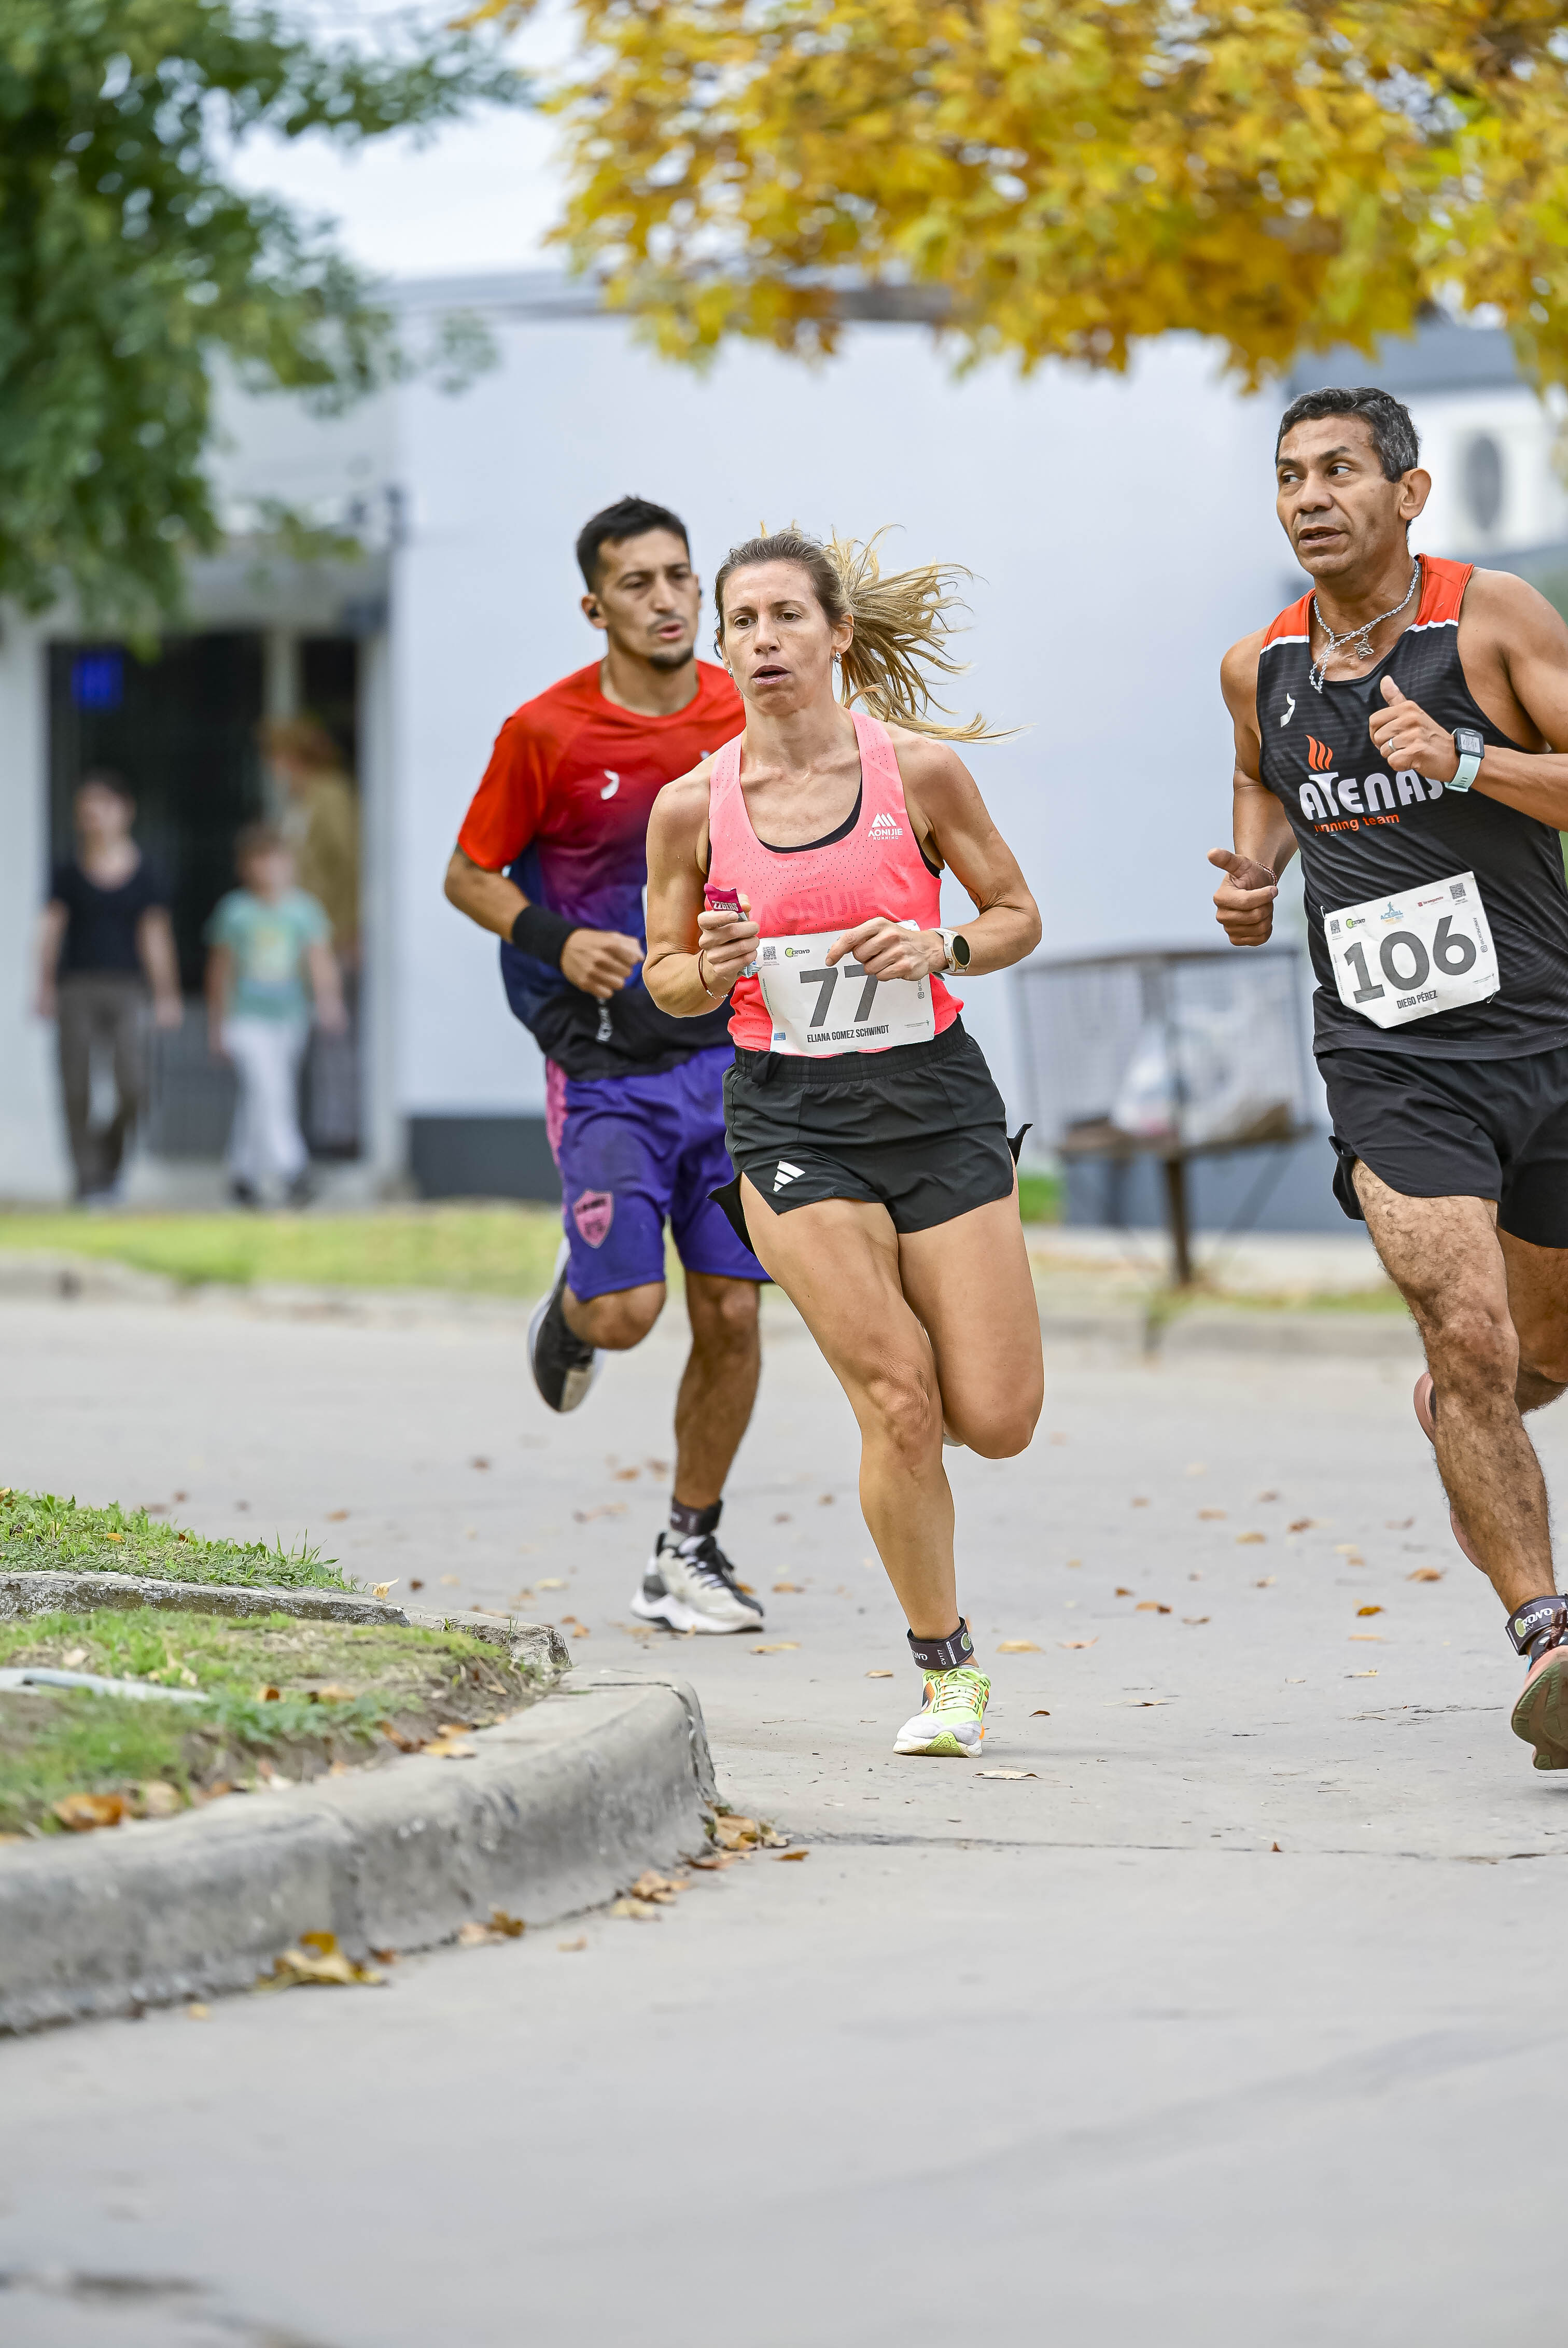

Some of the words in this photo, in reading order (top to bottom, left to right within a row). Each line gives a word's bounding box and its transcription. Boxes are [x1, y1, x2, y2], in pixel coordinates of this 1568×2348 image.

[1299, 769, 1443, 820] ATENAS
[1362, 814, 1400, 827] team
[711, 900, 739, 912] 226ERS
[1343, 915, 1477, 1004] 106
[799, 963, 879, 1028] 77
[1396, 996, 1416, 1009] DIEGO
[1417, 990, 1438, 1004] PÉREZ
[807, 1032, 831, 1043] ELIANA
[832, 1029, 855, 1040] GOMEZ
[856, 1025, 889, 1038] SCHWINDT
[937, 1649, 946, 1665] CV177
